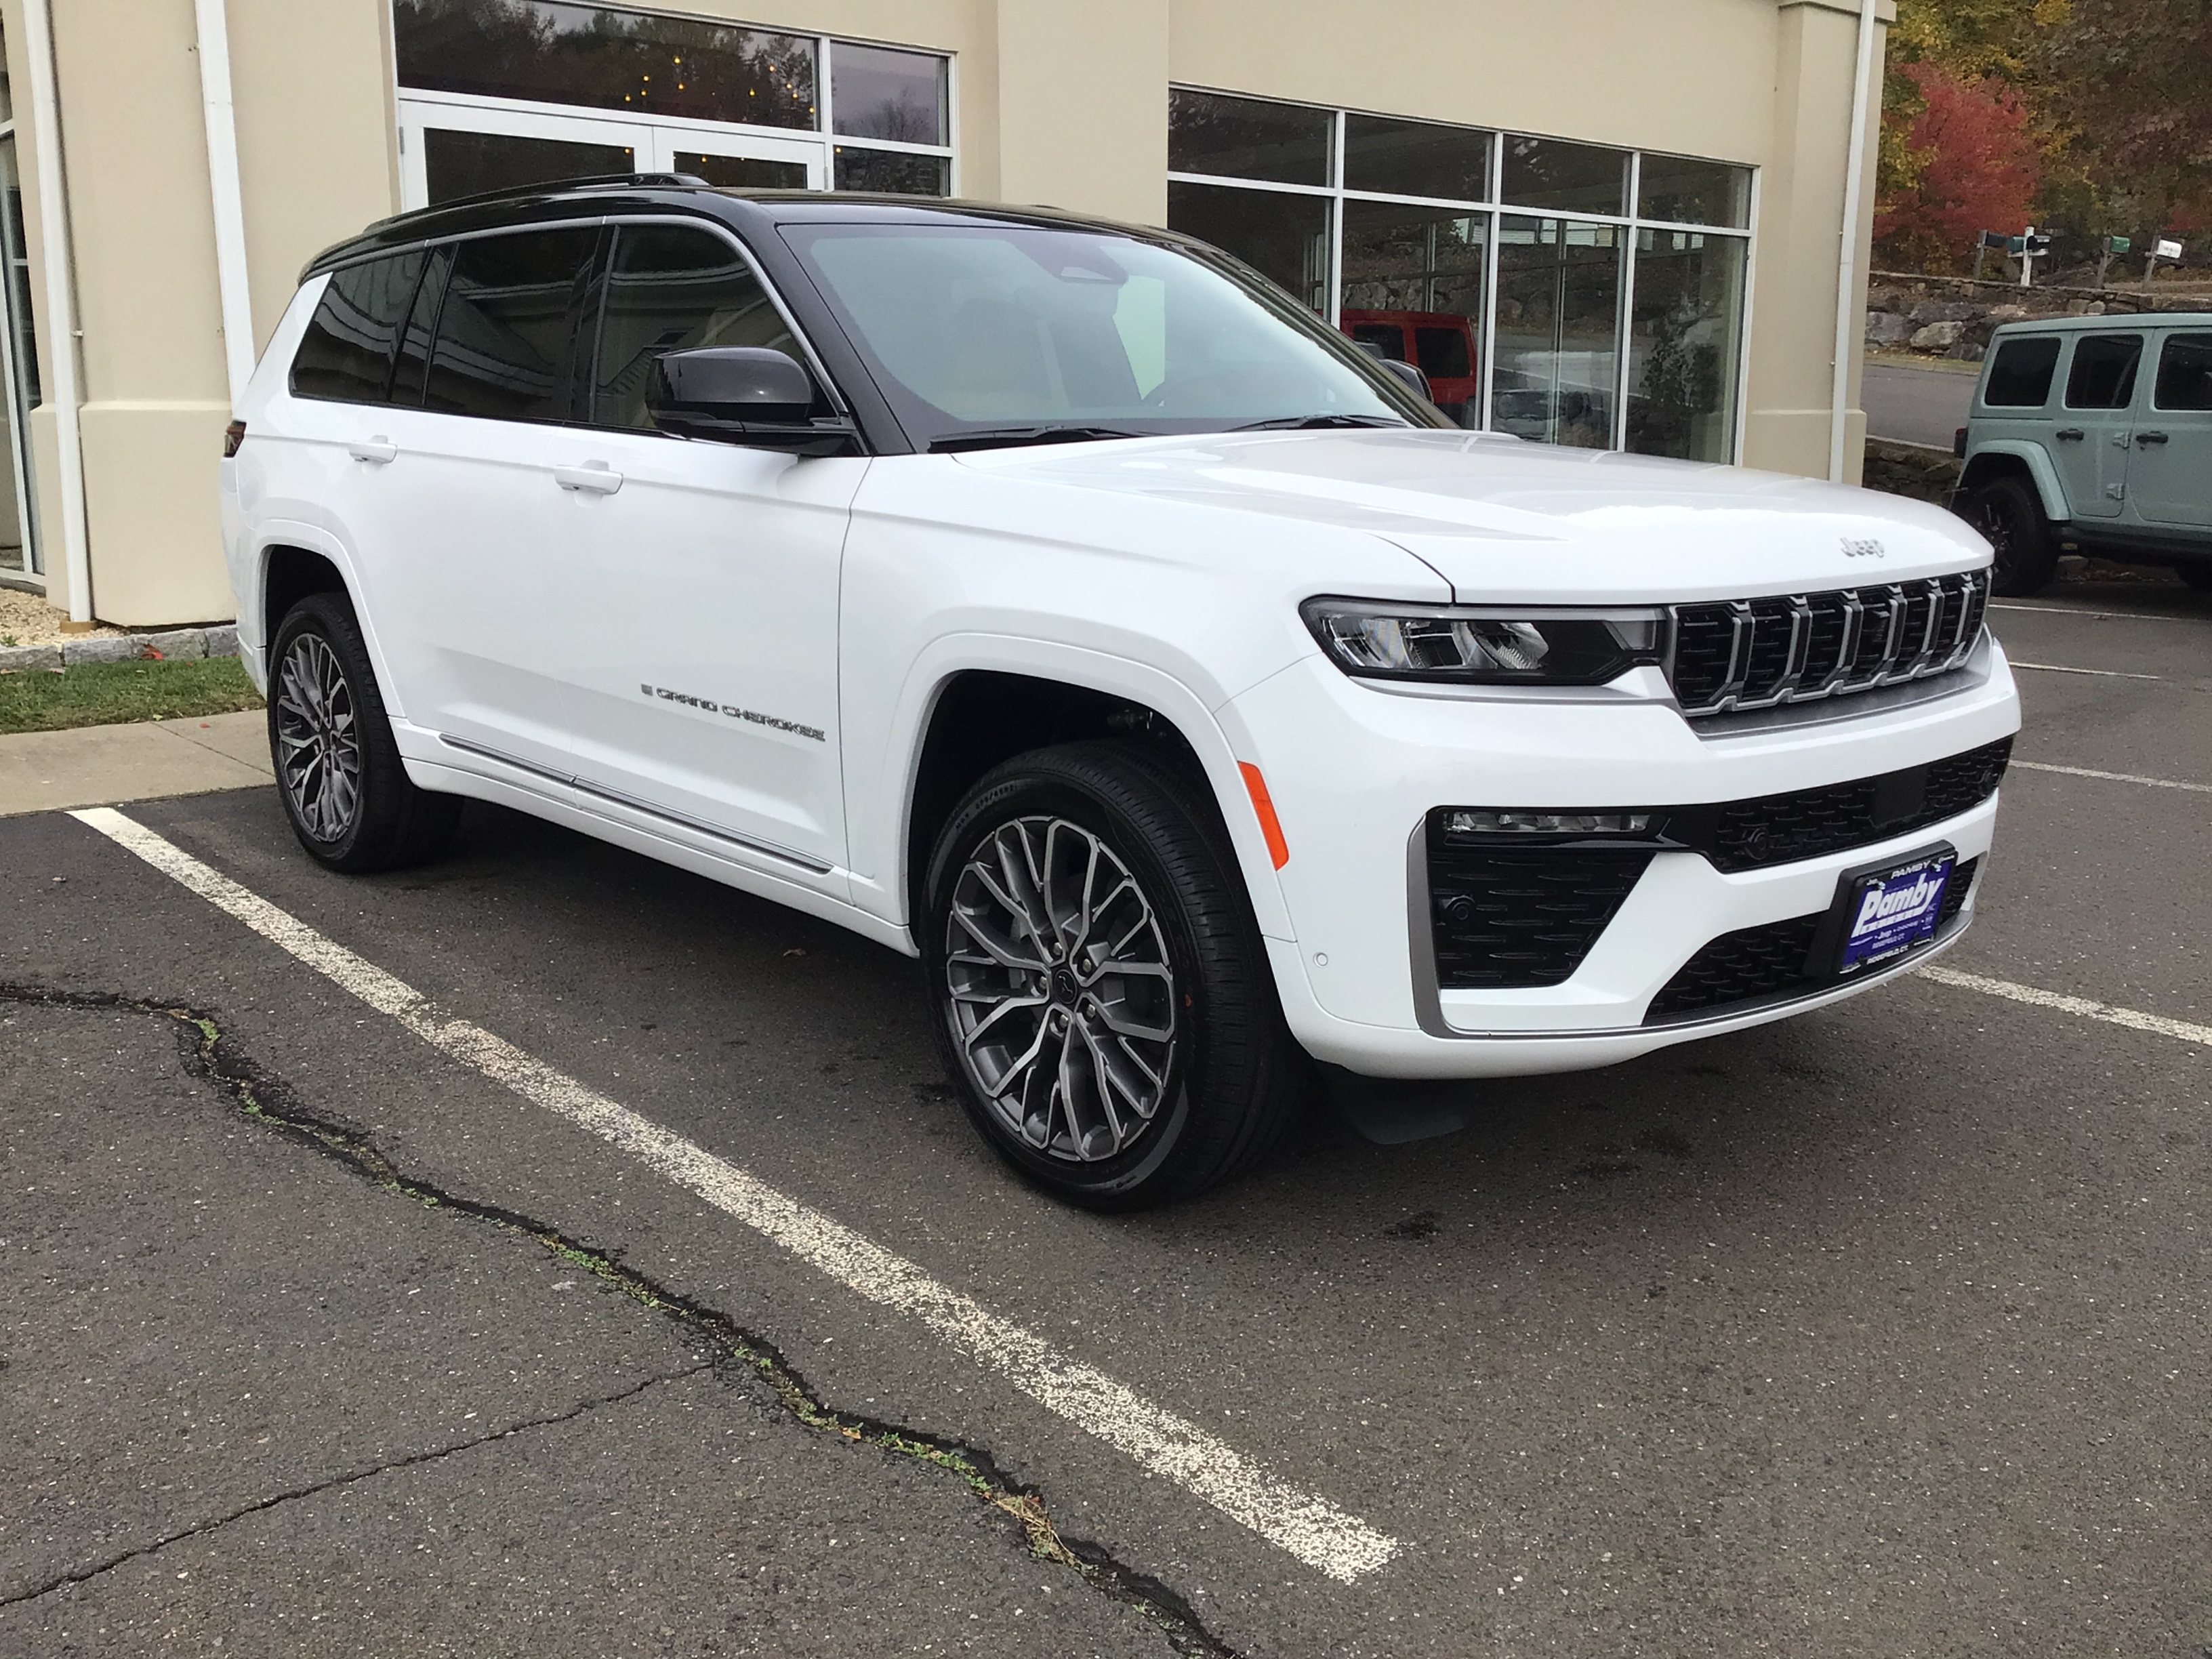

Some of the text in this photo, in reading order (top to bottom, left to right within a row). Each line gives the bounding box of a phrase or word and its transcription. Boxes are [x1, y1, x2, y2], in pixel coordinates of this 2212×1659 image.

[1839, 537, 1885, 558] Jeep
[656, 687, 825, 742] GRAND CHEROKEE
[1891, 860, 1931, 879] PAMBY
[1851, 873, 1944, 939] Pamby
